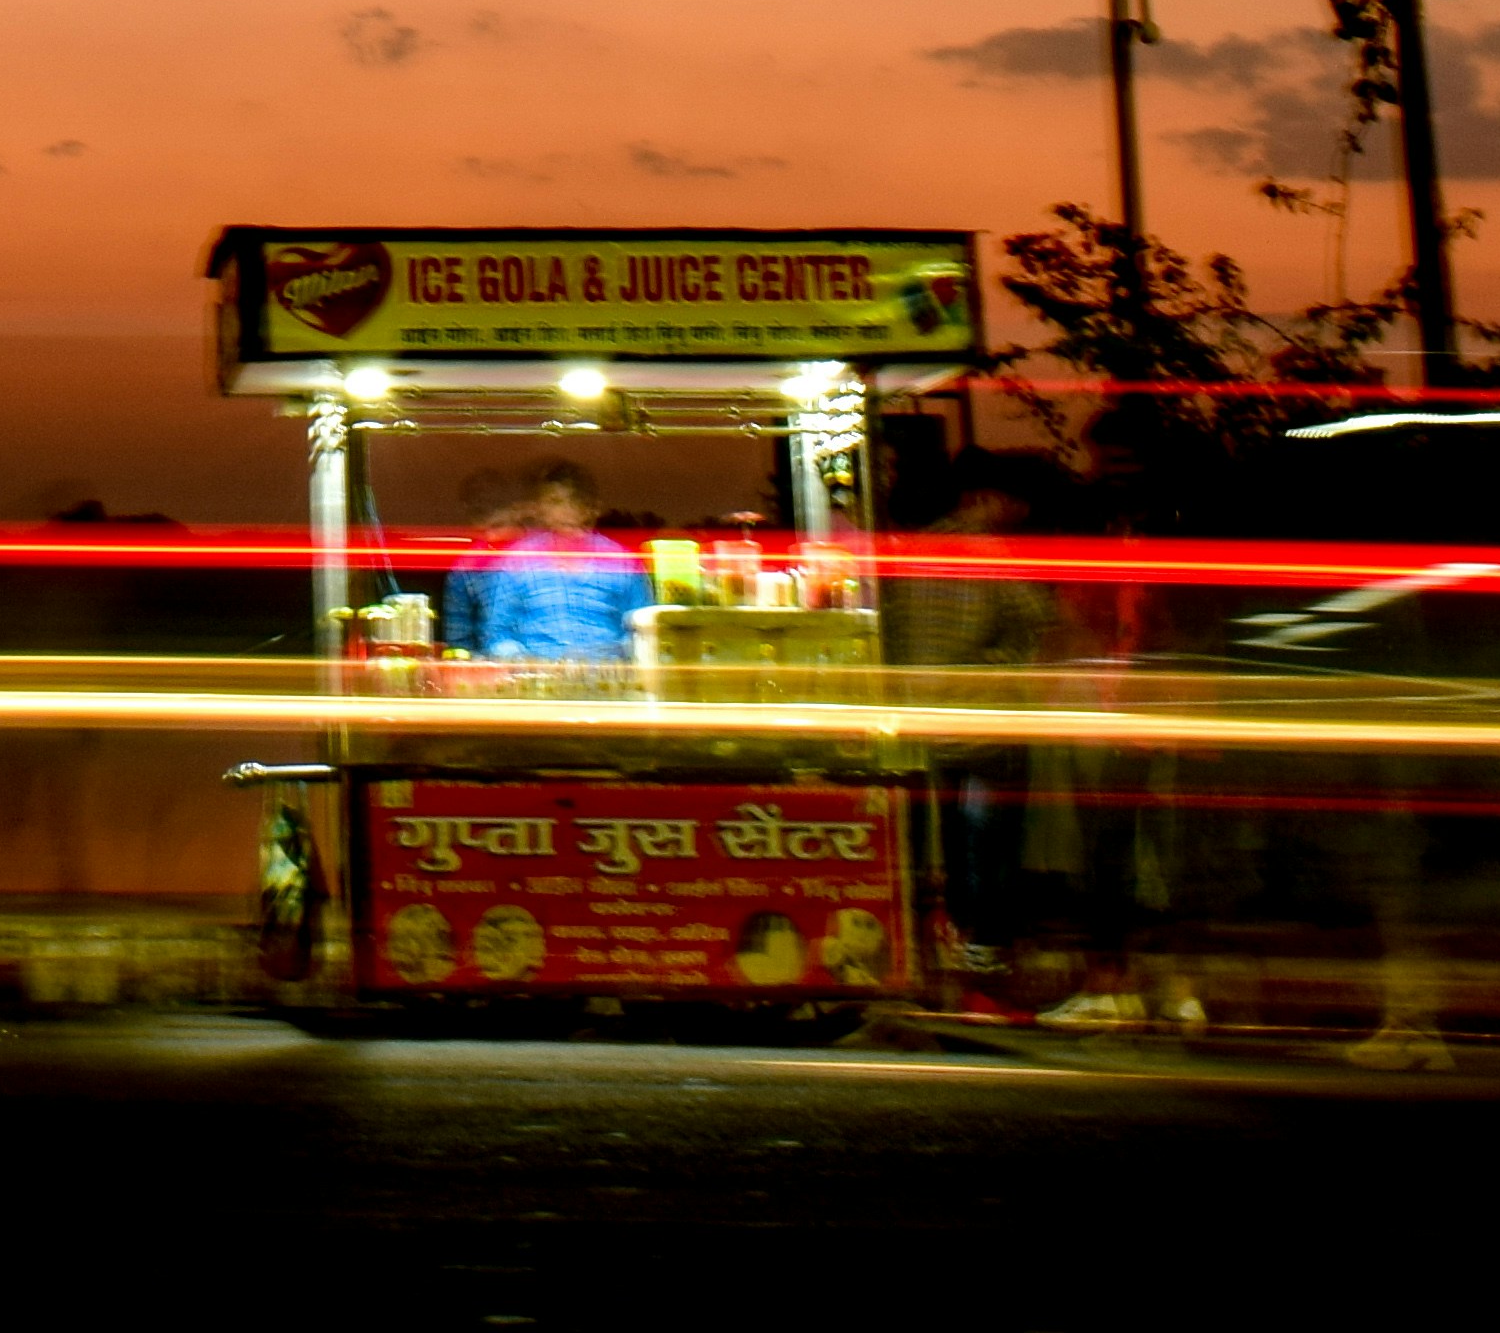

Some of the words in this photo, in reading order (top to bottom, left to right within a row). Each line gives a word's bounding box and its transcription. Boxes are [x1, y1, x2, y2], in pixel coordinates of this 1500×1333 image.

[406, 256, 465, 304] ICE
[478, 256, 571, 304] GOLA
[583, 255, 609, 303] &
[619, 254, 724, 303] JUICE
[735, 253, 874, 302] CENTER
[387, 816, 558, 873] गुप्ता
[572, 817, 699, 874] जुस
[712, 803, 877, 861] सेंटर
